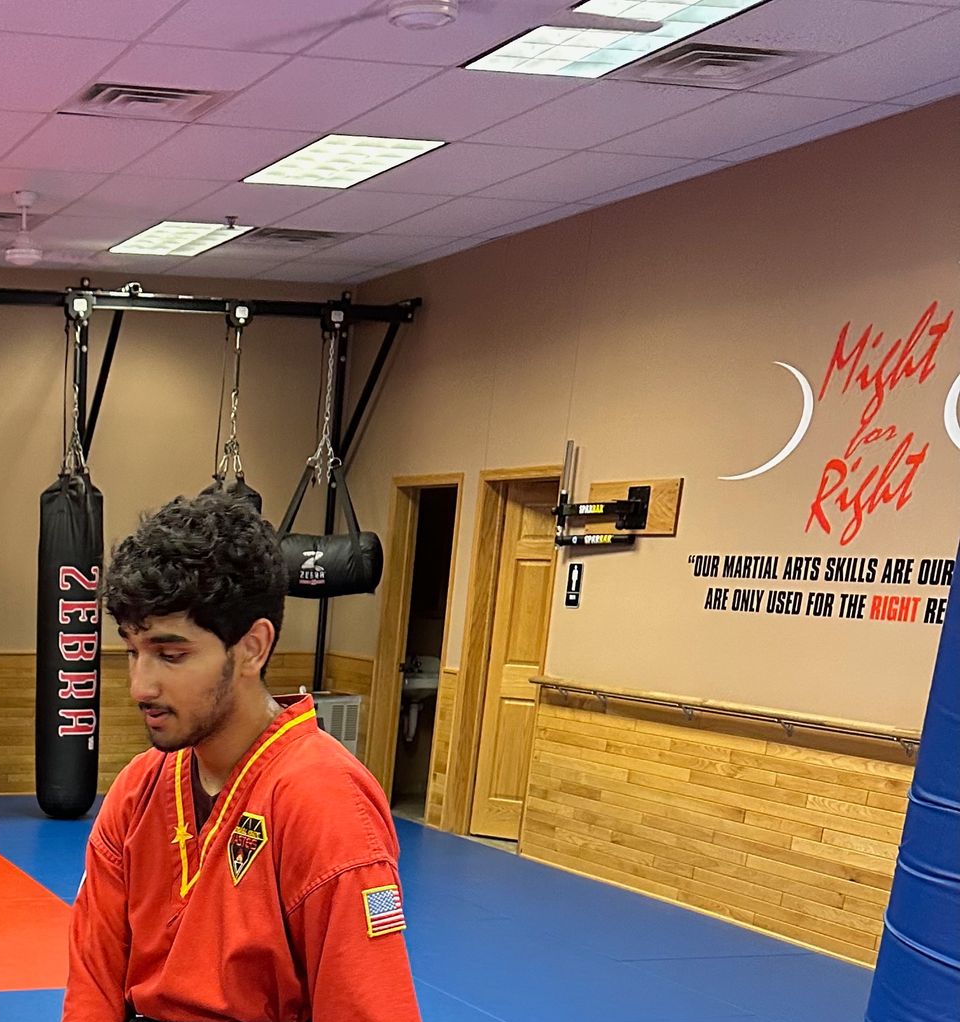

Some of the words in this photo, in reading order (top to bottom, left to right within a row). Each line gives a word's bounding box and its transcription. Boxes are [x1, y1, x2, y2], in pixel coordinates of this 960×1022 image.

[817, 300, 954, 423] Might
[804, 432, 930, 546] Right
[704, 587, 729, 610] ARE
[731, 589, 765, 613] ONLY
[766, 590, 803, 615] USED
[805, 592, 835, 617] FOR
[839, 594, 867, 619] THE
[869, 595, 922, 623] RIGHT
[722, 555, 778, 580] MARTIAL
[782, 556, 821, 581] ARTS
[824, 557, 878, 583] SKILLS
[880, 558, 915, 585] ARE
[917, 559, 955, 586] OUR
[58, 565, 99, 738] ZEBRA
